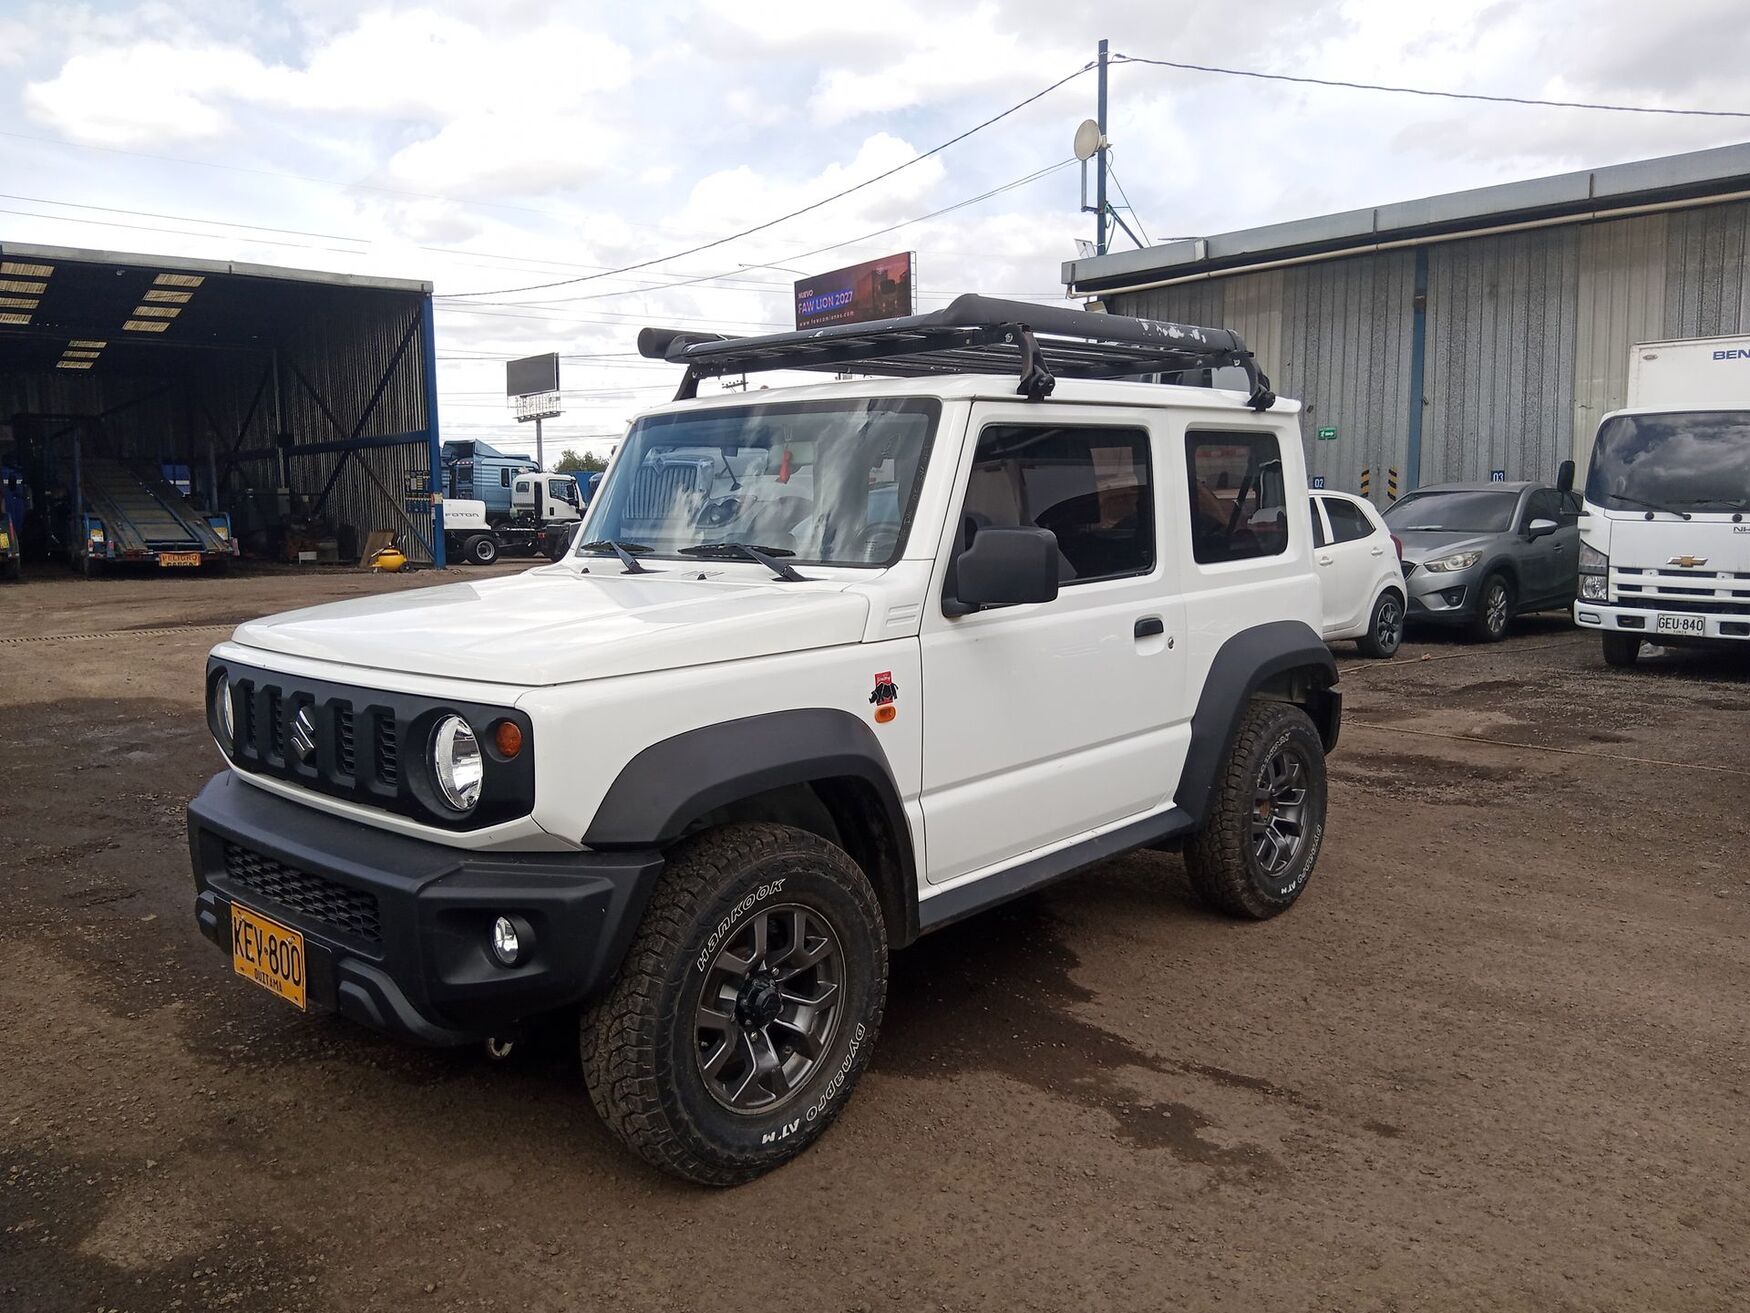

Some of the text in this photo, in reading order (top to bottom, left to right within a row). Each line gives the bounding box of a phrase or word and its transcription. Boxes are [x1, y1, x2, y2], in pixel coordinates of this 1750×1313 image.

[798, 300, 815, 315] FAW
[835, 290, 853, 306] 2027
[1493, 472, 1504, 482] 03
[1314, 478, 1324, 488] 02
[162, 554, 198, 562] PELIGRO
